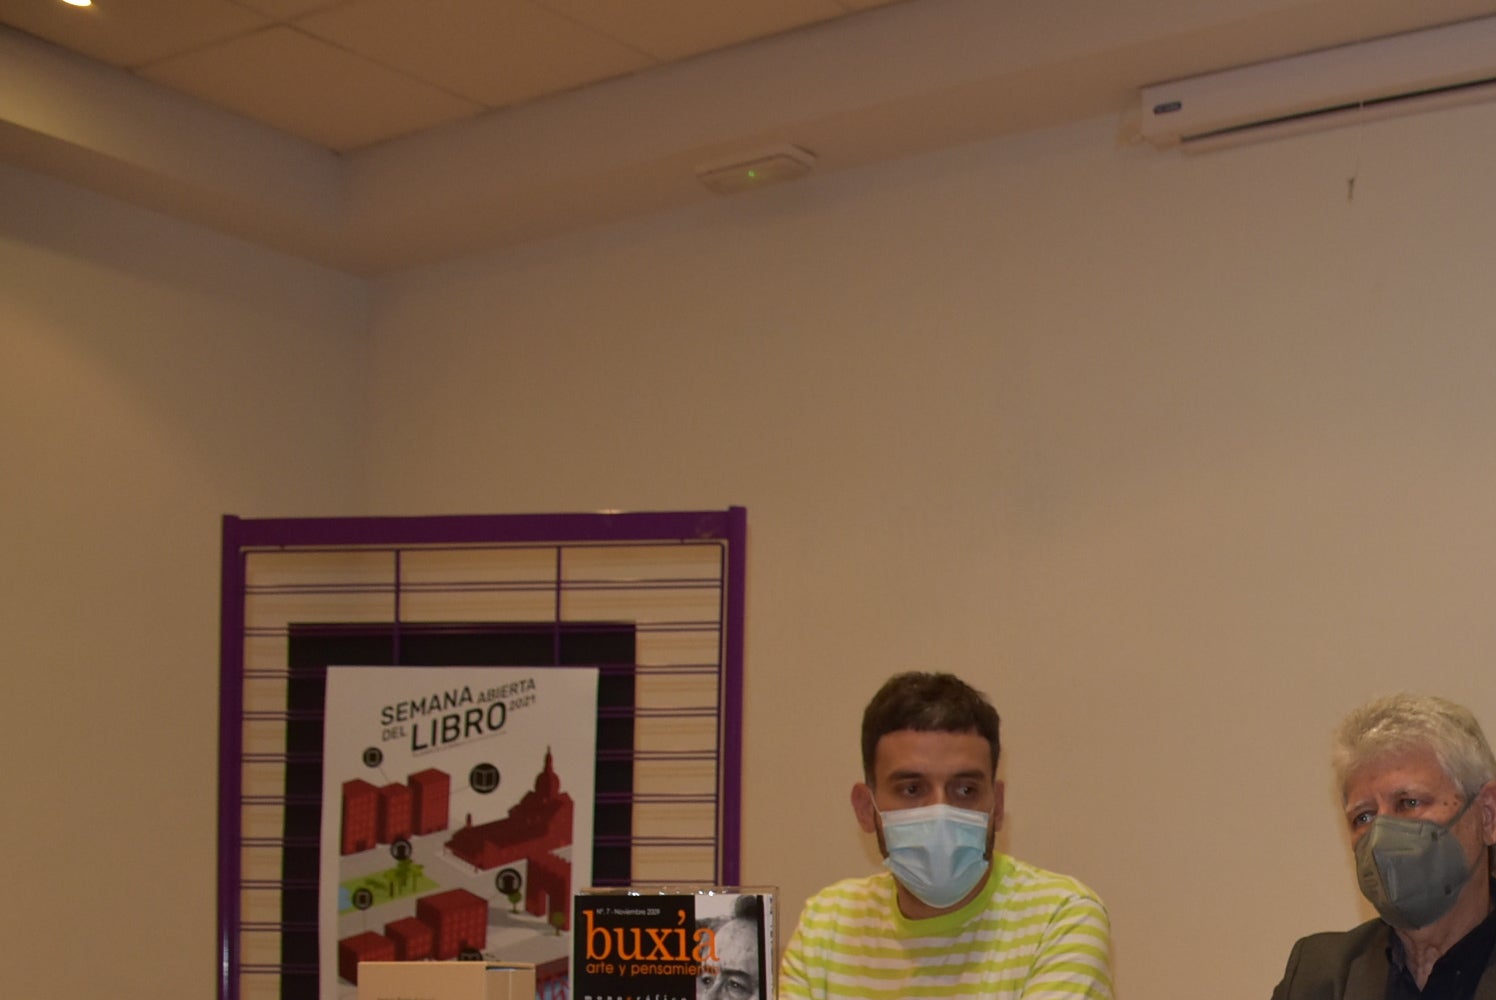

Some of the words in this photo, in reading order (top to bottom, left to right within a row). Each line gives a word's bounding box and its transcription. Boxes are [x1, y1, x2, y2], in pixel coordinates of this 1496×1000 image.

[381, 686, 472, 725] SEMANA
[477, 678, 536, 704] ABIERTA
[382, 726, 406, 742] DEL
[411, 701, 507, 751] LIBRO
[508, 694, 537, 711] 2021
[582, 909, 720, 963] buxía
[586, 962, 614, 974] arte
[619, 965, 626, 976] y
